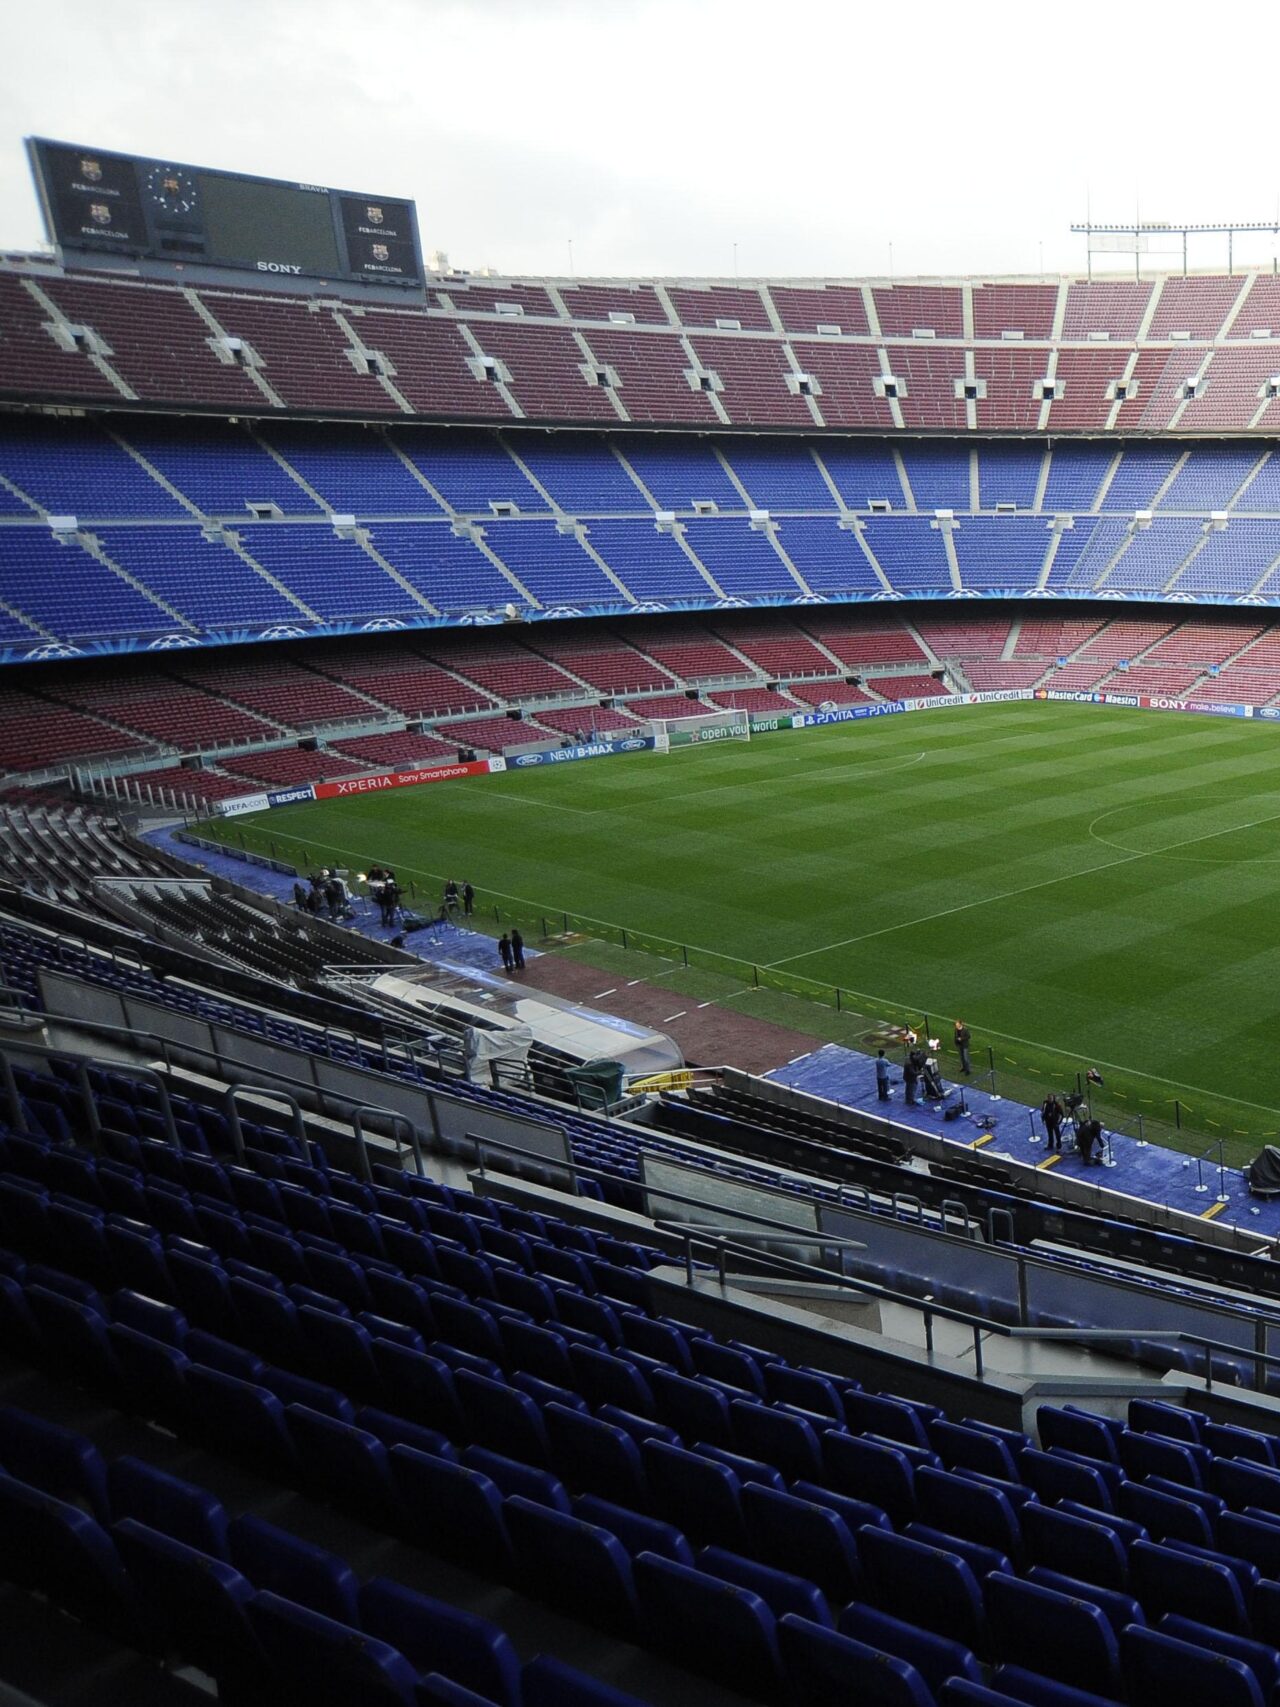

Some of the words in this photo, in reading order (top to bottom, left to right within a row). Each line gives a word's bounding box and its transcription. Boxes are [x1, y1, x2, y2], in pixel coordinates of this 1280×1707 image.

[256, 261, 302, 275] SONY
[925, 696, 964, 708] UniCredit
[979, 690, 1019, 702] UniCredit
[1047, 690, 1092, 702] MasterCard
[1105, 694, 1137, 706] Maestro
[1150, 698, 1188, 710] SONY
[752, 720, 778, 733] world
[702, 728, 726, 741] open
[550, 751, 574, 761] NEW
[577, 744, 614, 758] B-MAX
[338, 777, 392, 793] XPERIA
[398, 774, 419, 784] Sony
[420, 766, 468, 782] Smartphone
[275, 789, 312, 804] RESPECT
